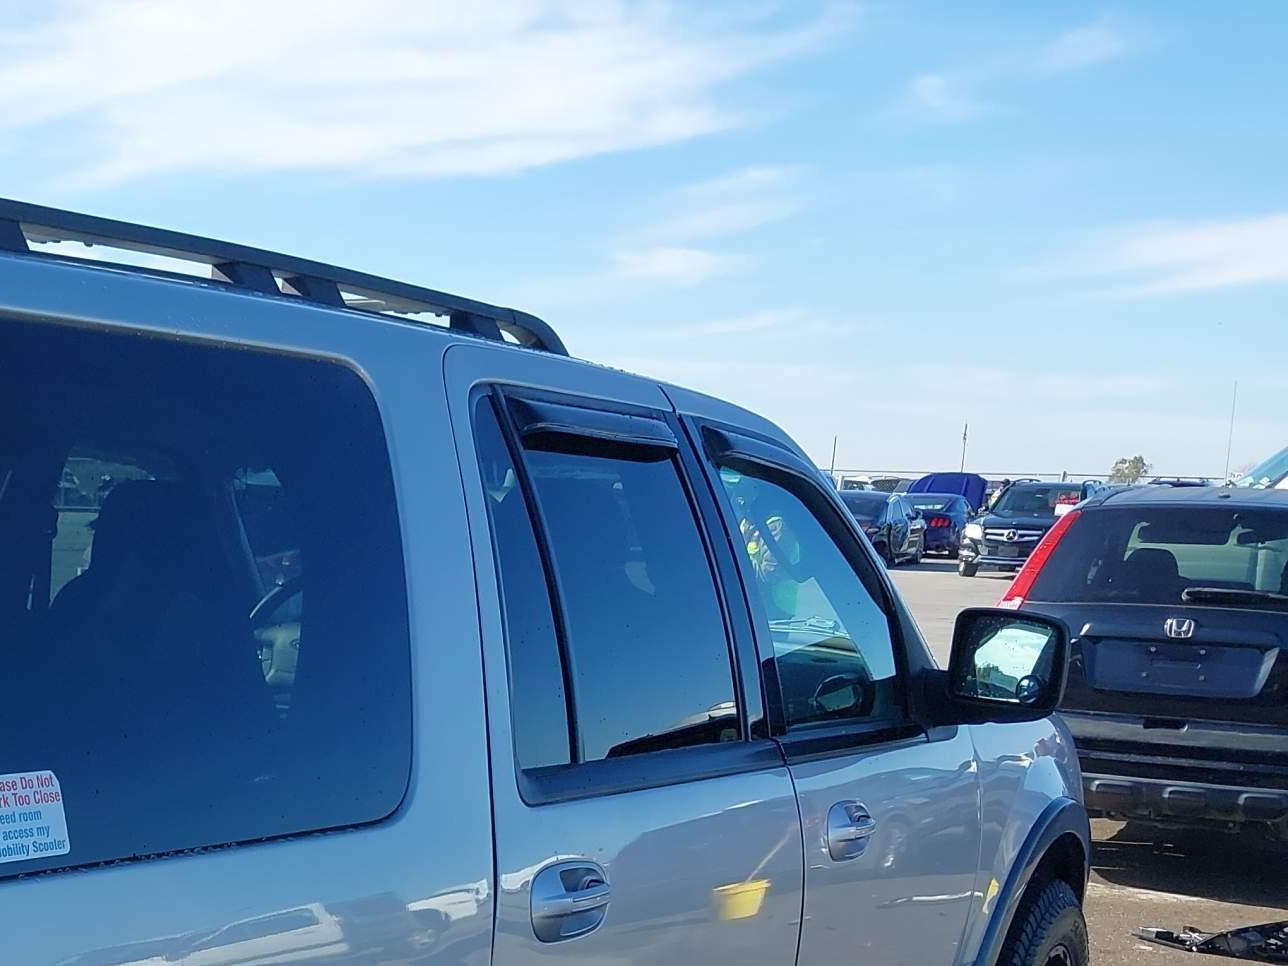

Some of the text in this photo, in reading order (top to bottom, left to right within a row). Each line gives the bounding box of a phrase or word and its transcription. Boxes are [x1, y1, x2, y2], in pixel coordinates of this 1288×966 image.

[20, 777, 34, 790] Do
[36, 775, 55, 788] Not
[12, 793, 30, 807] Too
[33, 791, 61, 804] Close
[18, 809, 42, 822] room
[2, 828, 34, 841] access
[36, 825, 51, 838] my
[32, 839, 67, 854] Scooter
